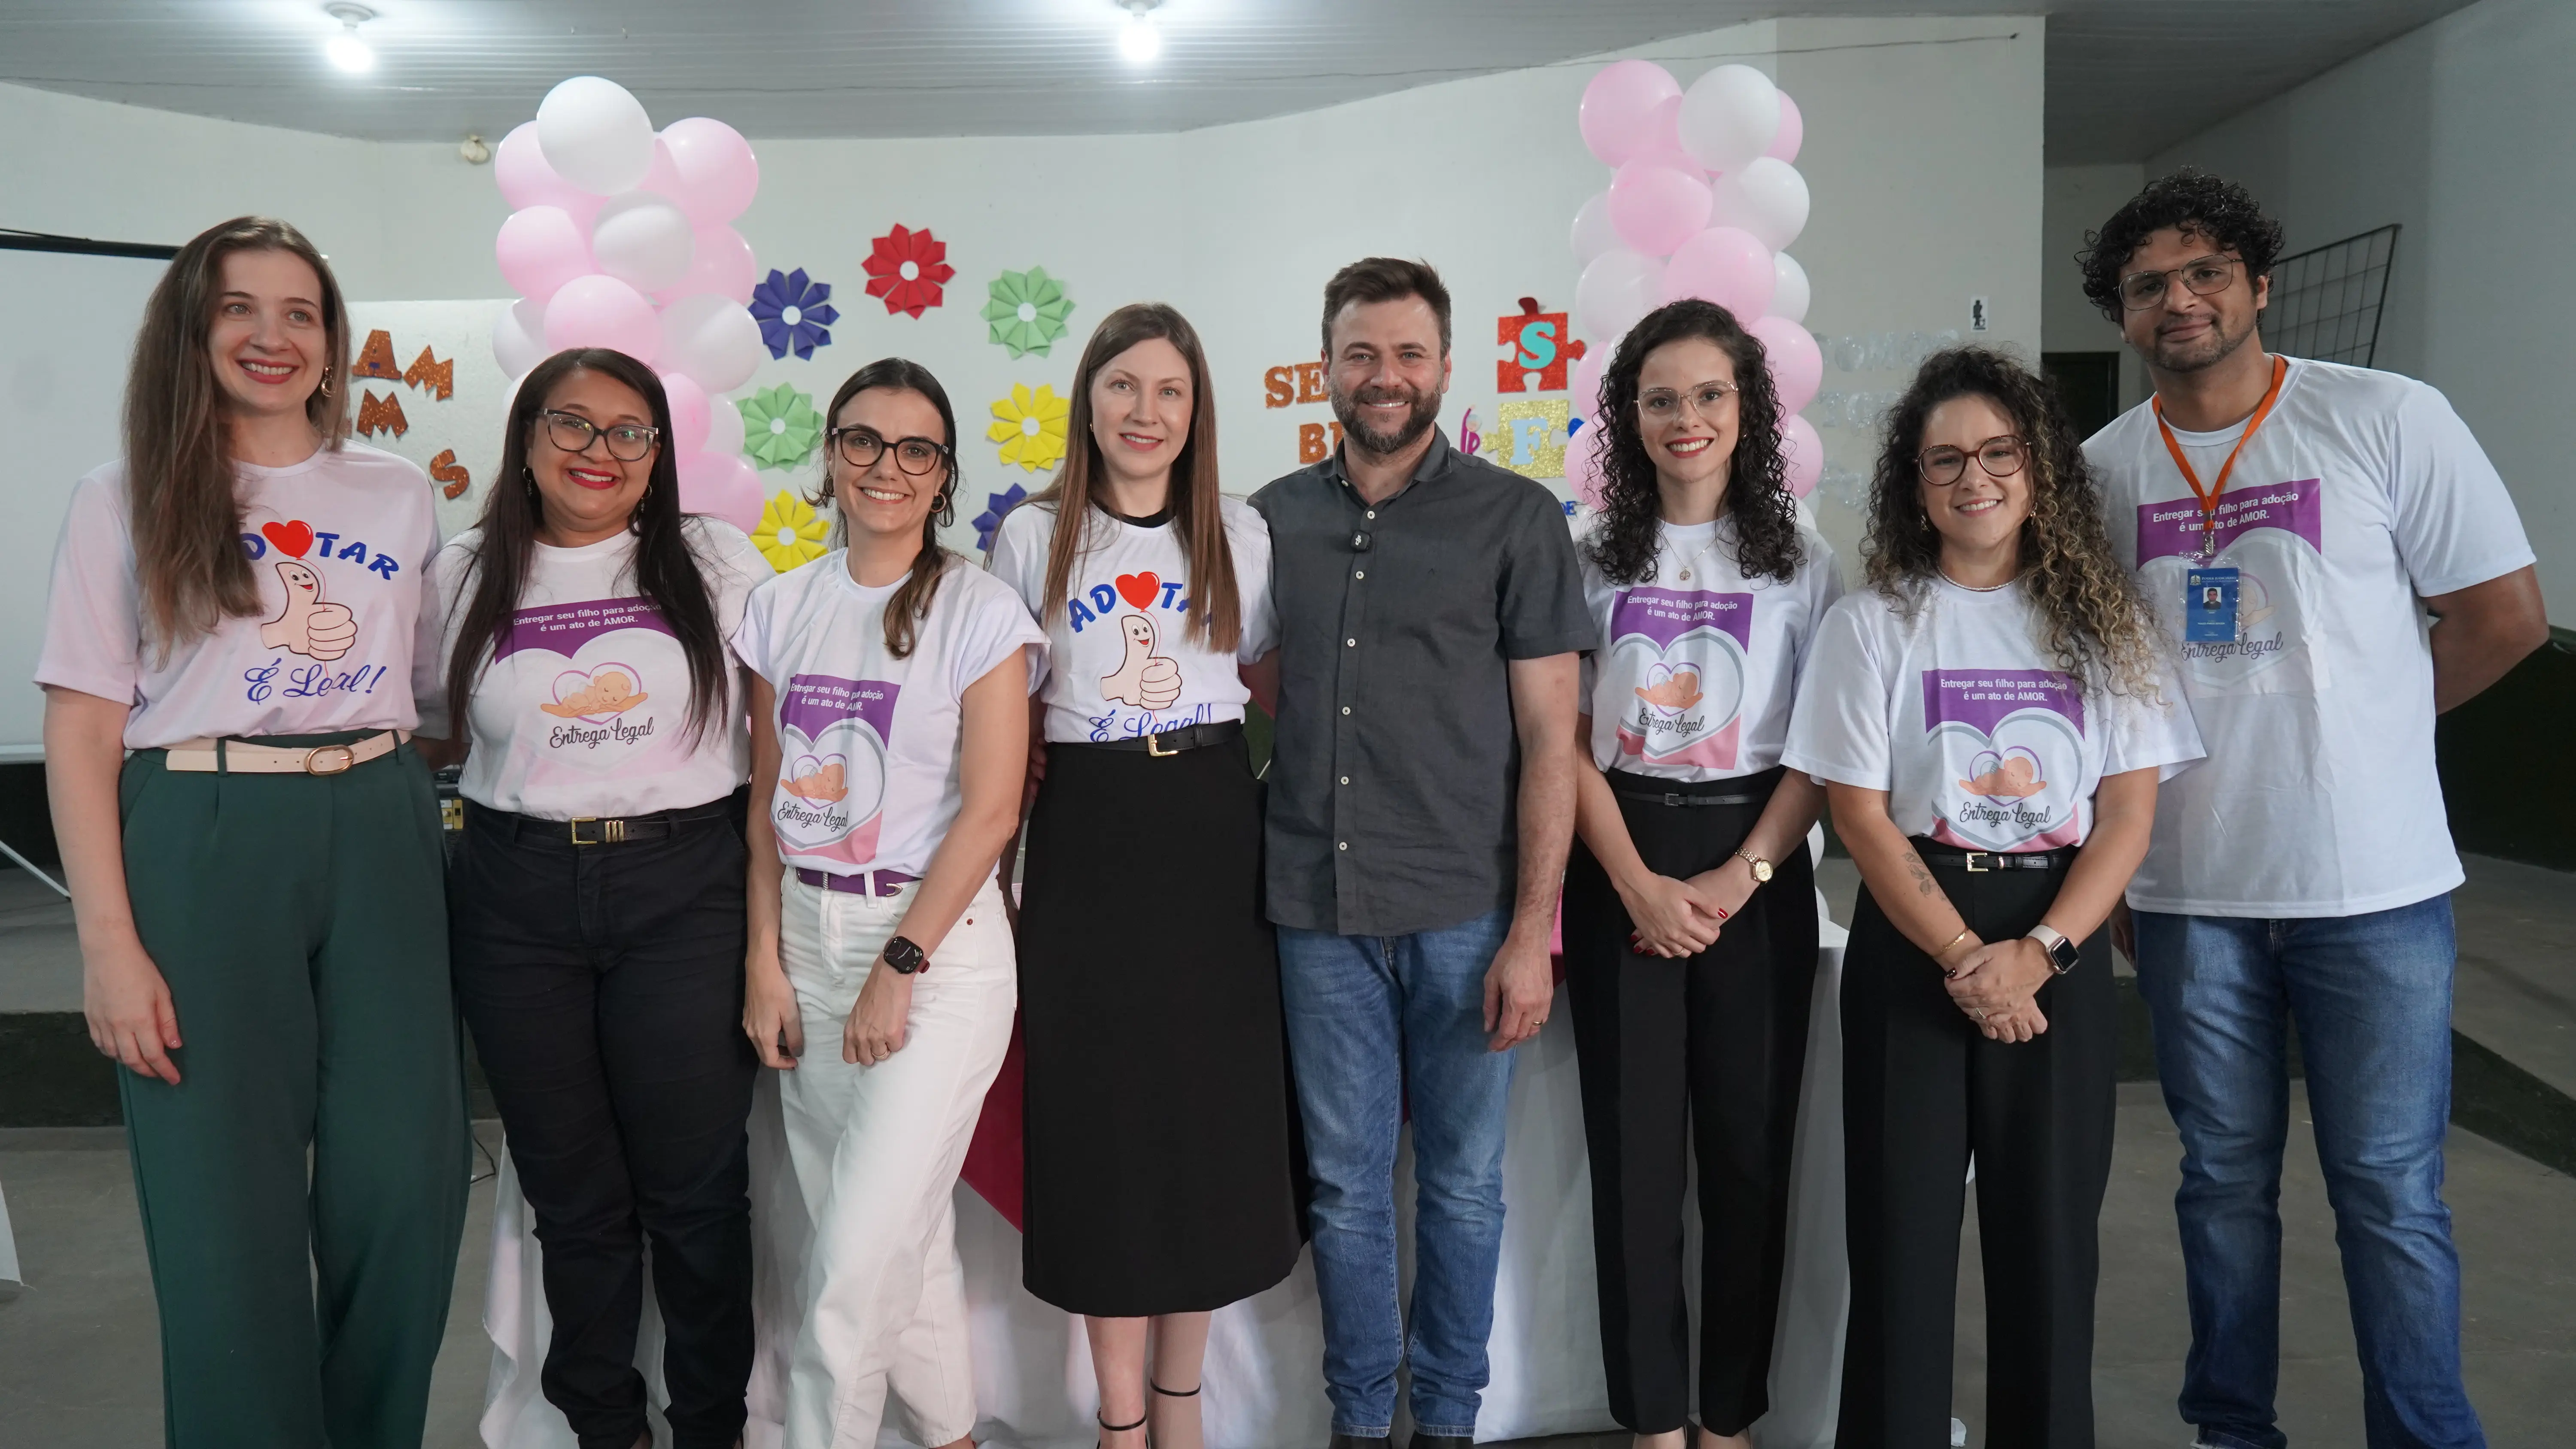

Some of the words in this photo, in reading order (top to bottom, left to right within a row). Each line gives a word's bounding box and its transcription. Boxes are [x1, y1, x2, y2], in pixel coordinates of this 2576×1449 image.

[1518, 321, 1556, 369] S
[1264, 362, 1329, 409] SE
[1509, 418, 1548, 465] F
[2153, 509, 2194, 522] Entregar
[2197, 508, 2215, 517] su
[2218, 503, 2238, 515] filho
[2240, 499, 2258, 512] para
[2261, 492, 2299, 505] adoção
[2179, 522, 2185, 532] é
[2189, 523, 2204, 531] um
[2213, 521, 2224, 530] to
[2227, 517, 2237, 527] de
[2239, 509, 2269, 524] AMOR.
[1627, 596, 1659, 605] Entregar
[1661, 599, 1674, 607] seu
[1676, 600, 1693, 609] filho
[1694, 600, 1708, 610] para
[1710, 601, 1738, 611] adoção
[1647, 607, 1652, 615] é
[1681, 613, 1691, 621] de
[1693, 610, 1715, 621] AMOR.
[513, 615, 553, 625] Entregar
[577, 609, 599, 618] filho
[603, 608, 624, 617] para
[604, 615, 638, 625] AMOR.
[2238, 631, 2283, 660] Legal
[244, 658, 282, 705] É
[790, 683, 816, 694] Entregar
[832, 687, 850, 697] filho
[861, 689, 884, 701] adoção
[1941, 679, 1975, 689] Entregar
[1995, 679, 2014, 688] filho
[2017, 680, 2036, 690] para
[2038, 679, 2067, 691] adoção
[801, 695, 807, 704] é
[808, 697, 819, 706] um
[821, 699, 833, 707] ato
[835, 700, 845, 709] de
[1963, 691, 1969, 700] é
[1988, 692, 2002, 700] ato
[2004, 691, 2015, 700] de
[2017, 692, 2047, 701] AMOR.
[550, 725, 610, 749] Entrega
[611, 717, 654, 745] Legal
[1675, 713, 1704, 737] Legal
[778, 801, 823, 828] Entrega
[823, 806, 849, 832] Legal
[1959, 802, 2011, 828] Entrega
[2012, 802, 2050, 829] Legal
